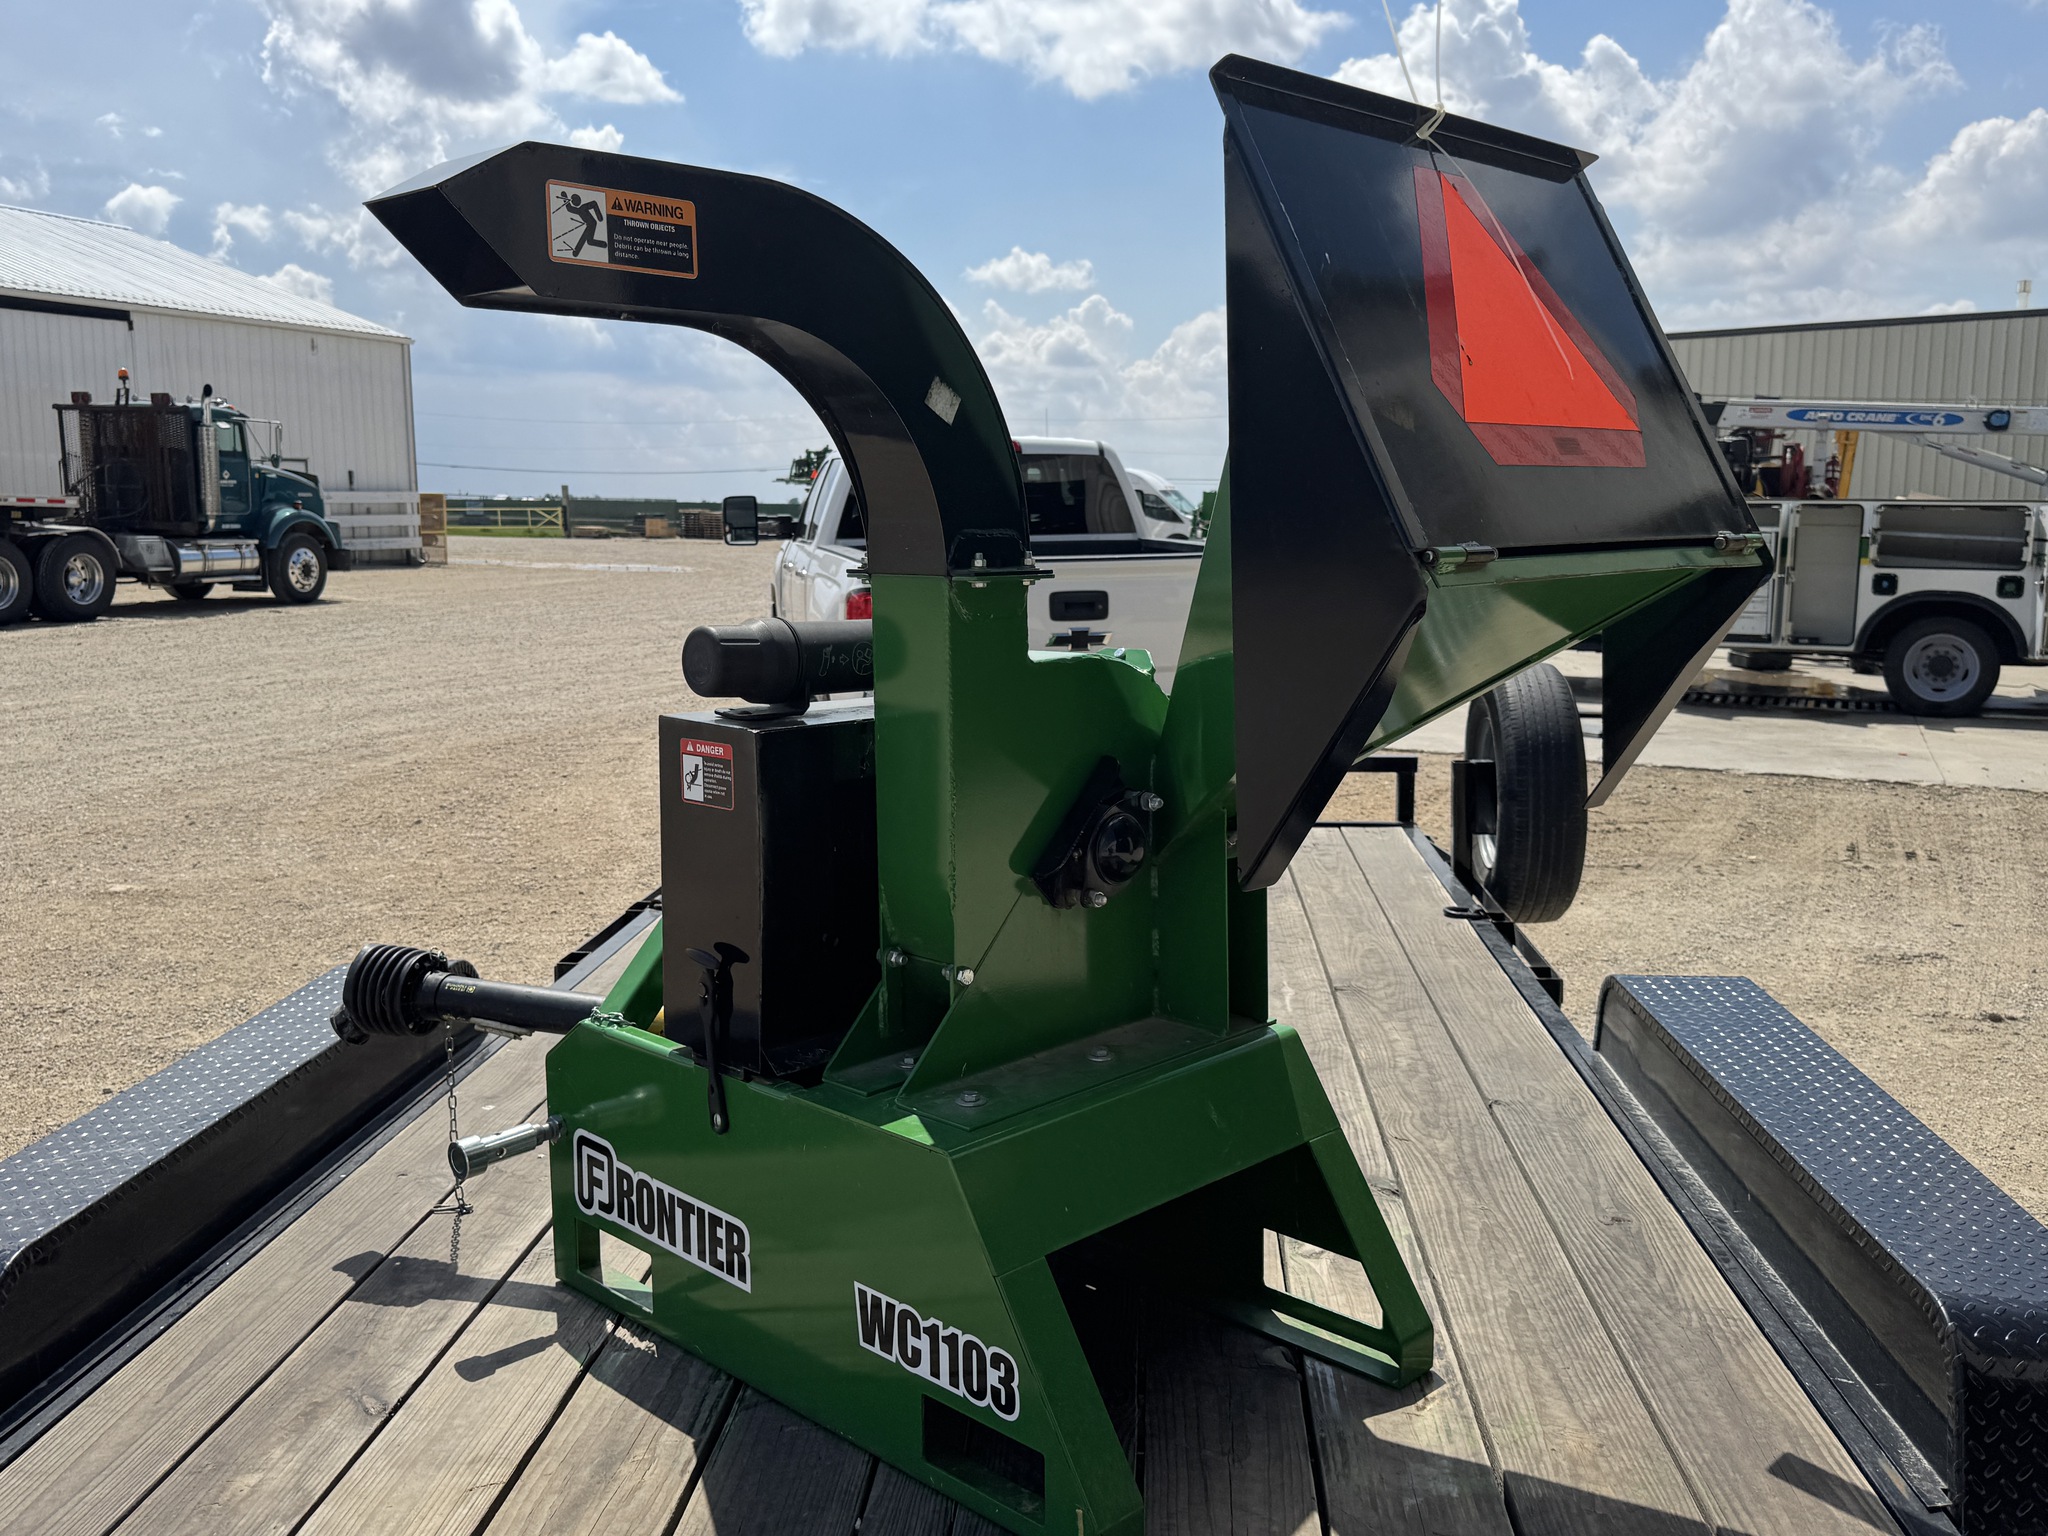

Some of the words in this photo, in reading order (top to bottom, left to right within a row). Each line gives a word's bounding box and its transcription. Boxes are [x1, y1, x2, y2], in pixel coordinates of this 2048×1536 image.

[624, 198, 684, 220] WARNING
[624, 219, 649, 229] THROWN
[650, 223, 676, 233] OBJECTS
[614, 242, 632, 250] Debris
[652, 247, 672, 256] thrown
[677, 251, 690, 259] long
[634, 237, 655, 245] operate
[669, 242, 689, 250] people.
[614, 251, 640, 260] distance.
[1846, 412, 1897, 423] CRANE
[696, 743, 724, 756] DANGER
[575, 1133, 748, 1286] FRONTIER
[857, 1286, 1017, 1417] WC1103
